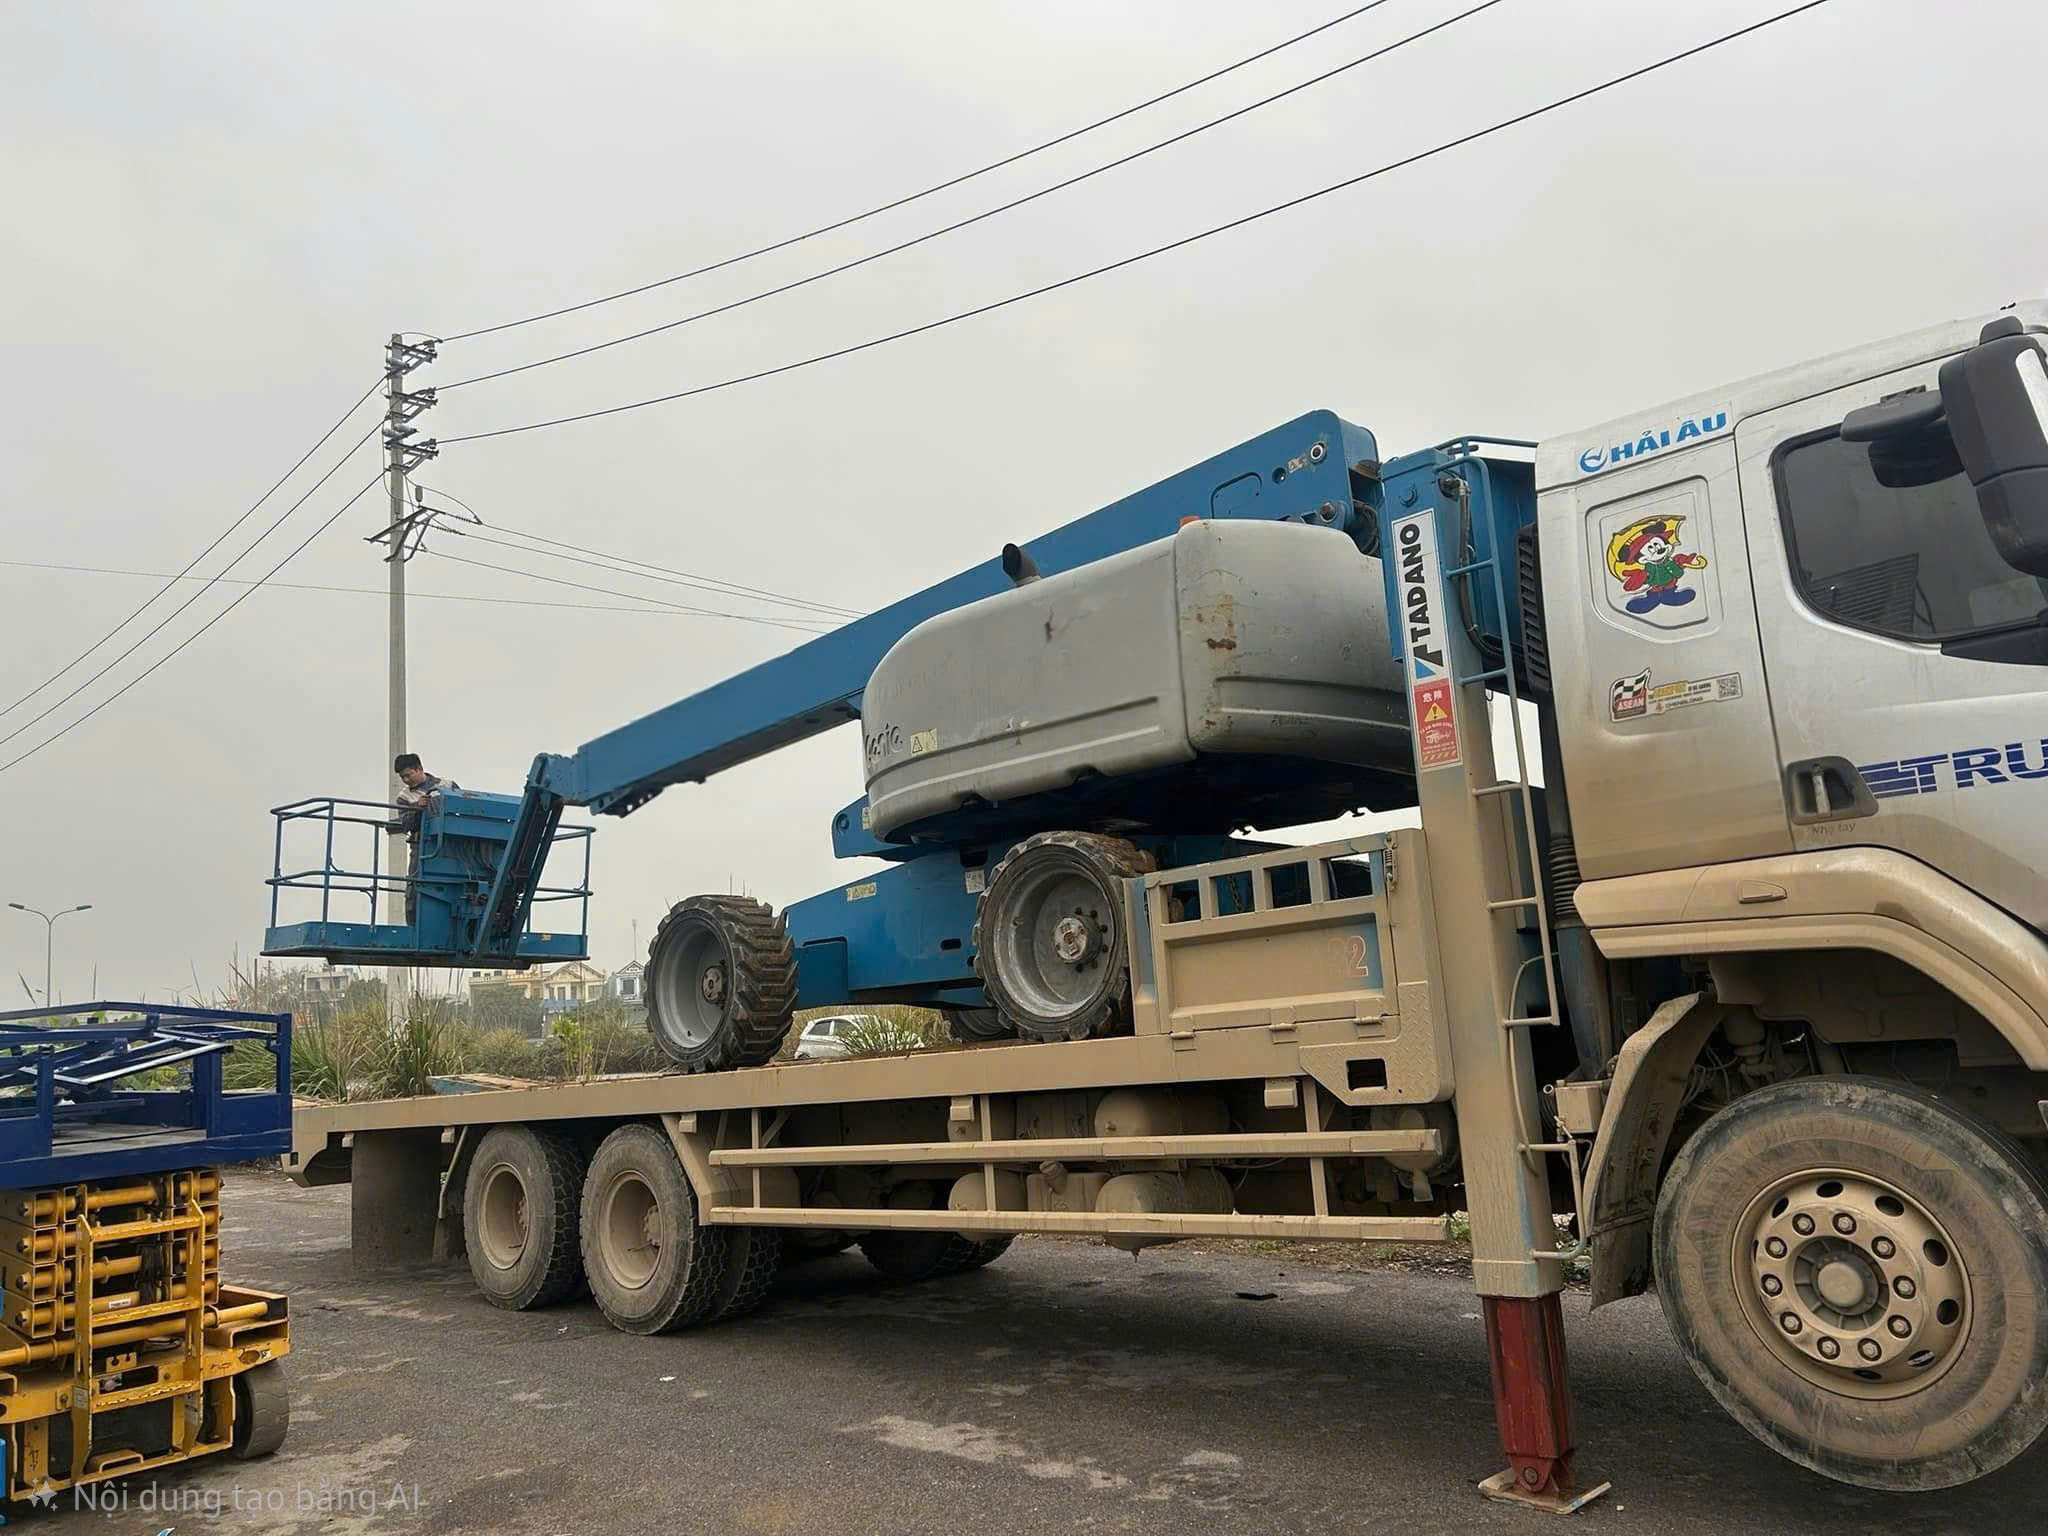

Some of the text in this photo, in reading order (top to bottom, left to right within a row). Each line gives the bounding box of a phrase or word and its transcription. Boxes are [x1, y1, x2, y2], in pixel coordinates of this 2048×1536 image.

[1611, 412, 1727, 463] HẢI ÂU
[1399, 523, 1432, 643] TADANO
